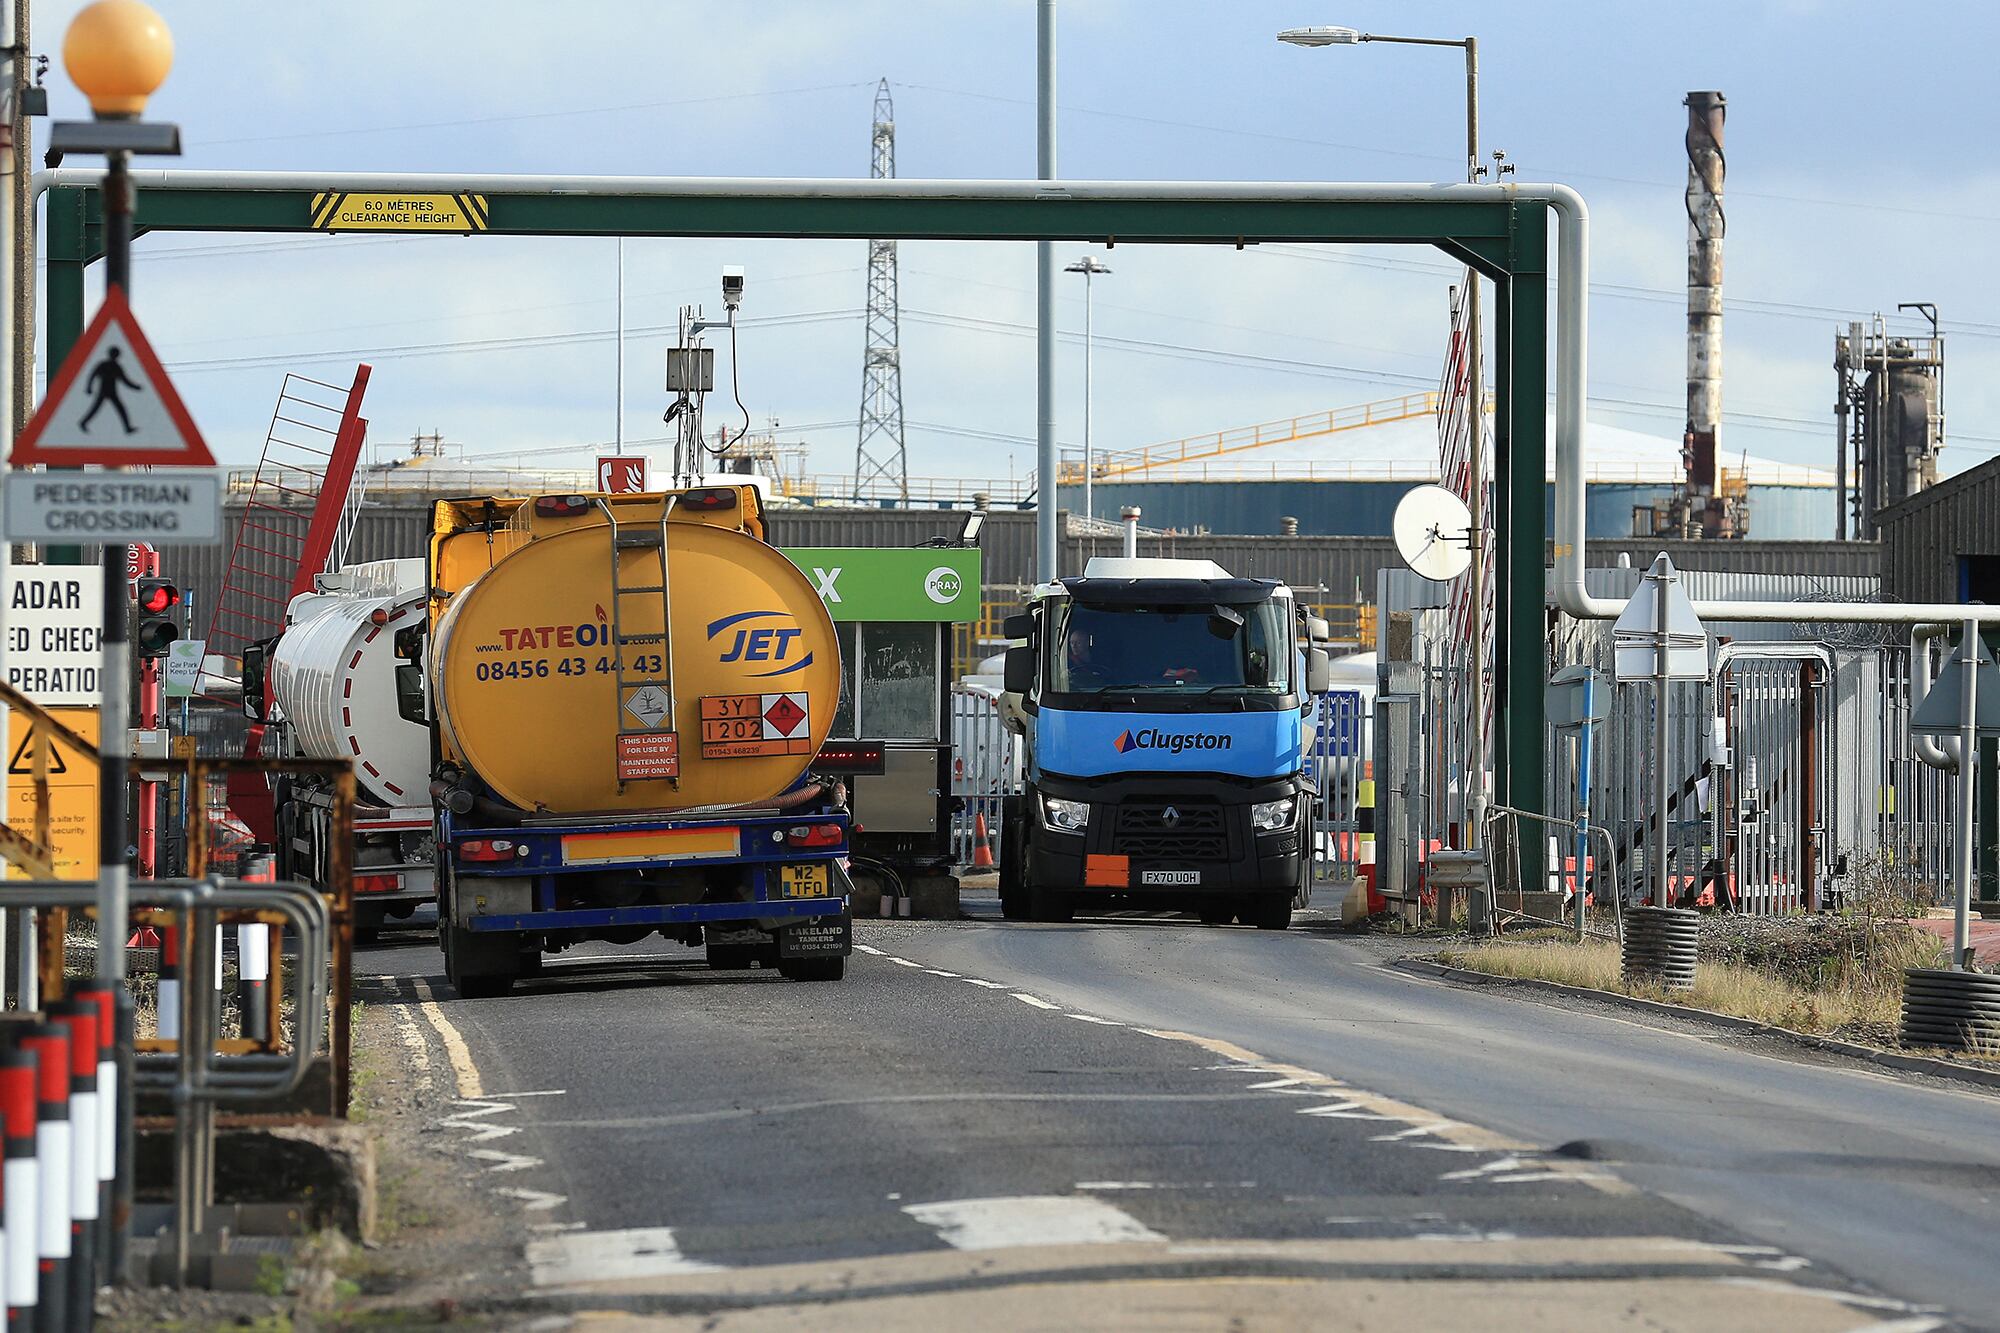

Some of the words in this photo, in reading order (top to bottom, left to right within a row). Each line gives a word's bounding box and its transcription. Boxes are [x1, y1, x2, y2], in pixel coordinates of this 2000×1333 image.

[364, 201, 382, 211] 6.0
[341, 213, 410, 223] CLEARANCE
[415, 213, 456, 223] HEIGHT
[34, 484, 189, 505] PEDESTRIAN
[46, 510, 178, 532] CROSSING
[128, 543, 139, 573] STOP
[930, 581, 958, 590] PRAX
[12, 581, 80, 609] ADAR
[719, 628, 802, 663] JET
[476, 659, 549, 682] 08456
[557, 657, 586, 677] 43
[633, 655, 662, 673] 43
[9, 667, 102, 692] PERATIO
[642, 736, 672, 744] LADDER
[1135, 728, 1232, 754] Clugston
[621, 758, 676, 766] MAINTENANCE
[795, 866, 813, 879] W2
[1146, 872, 1174, 883] FX70
[1176, 872, 1196, 883] UOH
[794, 881, 822, 895] TFO
[788, 927, 844, 936] LAKELAND
